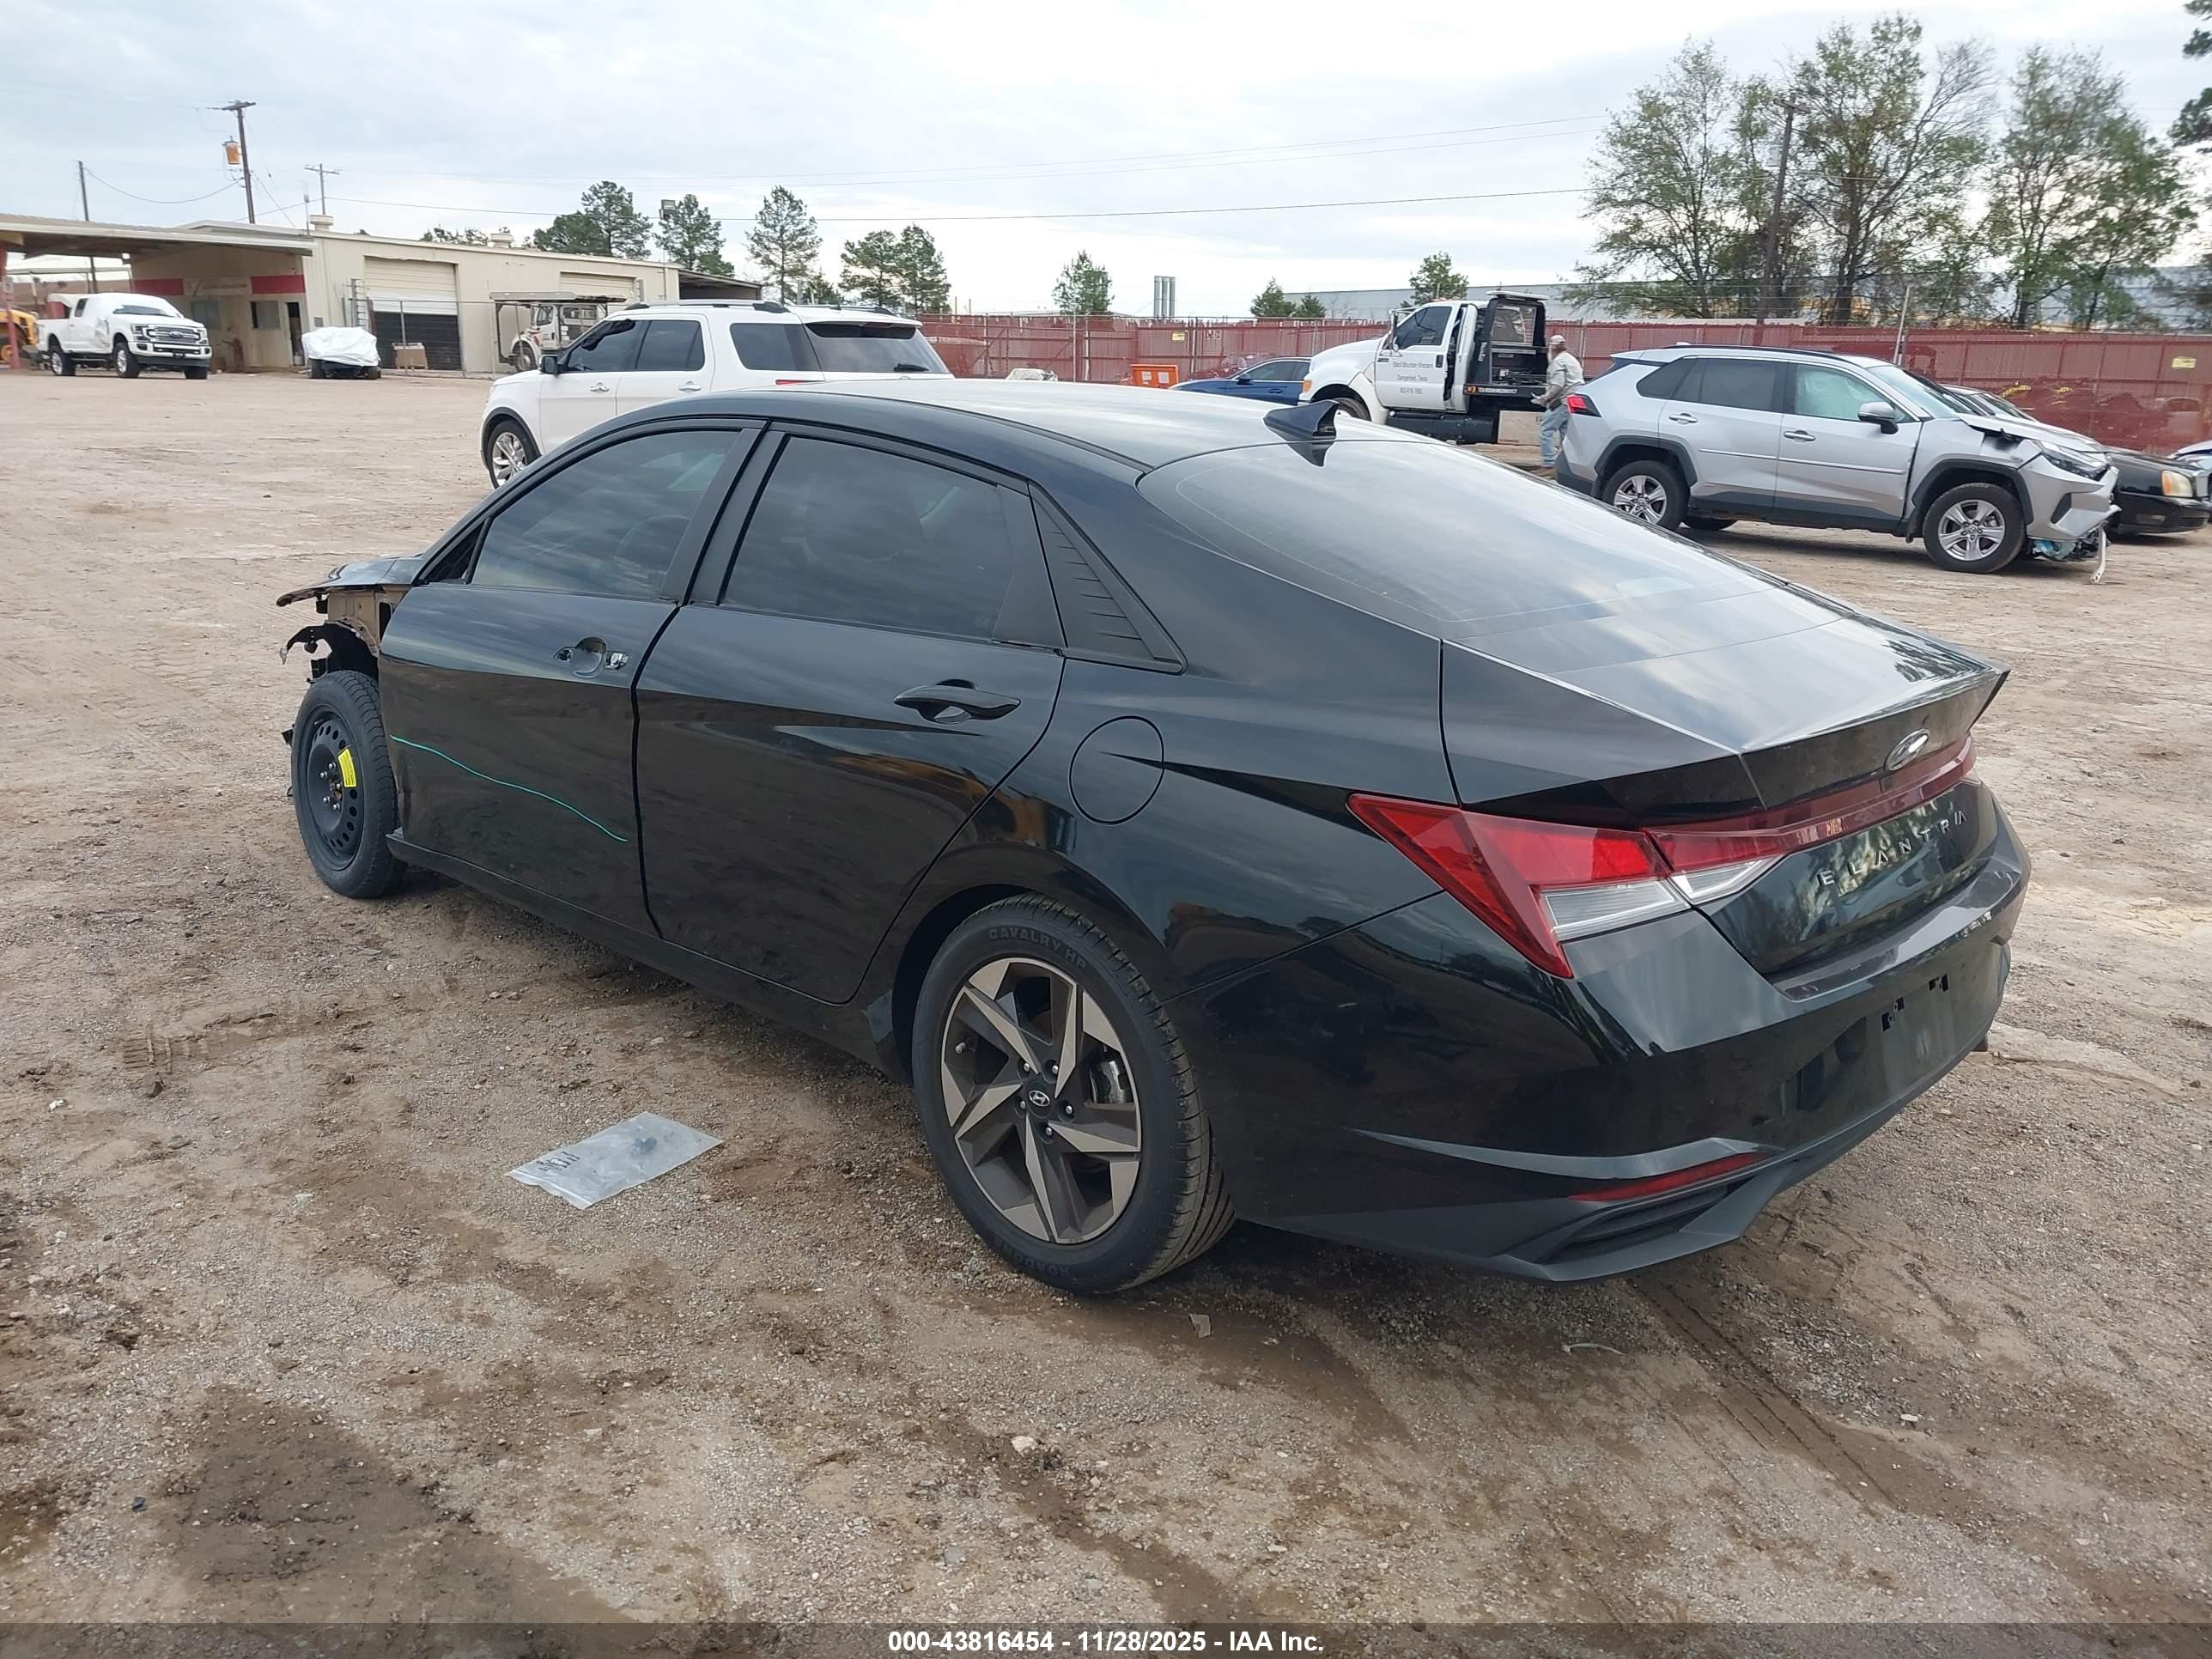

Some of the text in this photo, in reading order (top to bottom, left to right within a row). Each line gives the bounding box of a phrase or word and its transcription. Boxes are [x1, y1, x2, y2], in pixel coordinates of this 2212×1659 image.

[1820, 809, 1967, 886] ELANTRA
[988, 926, 1087, 969] CAVALRY HP
